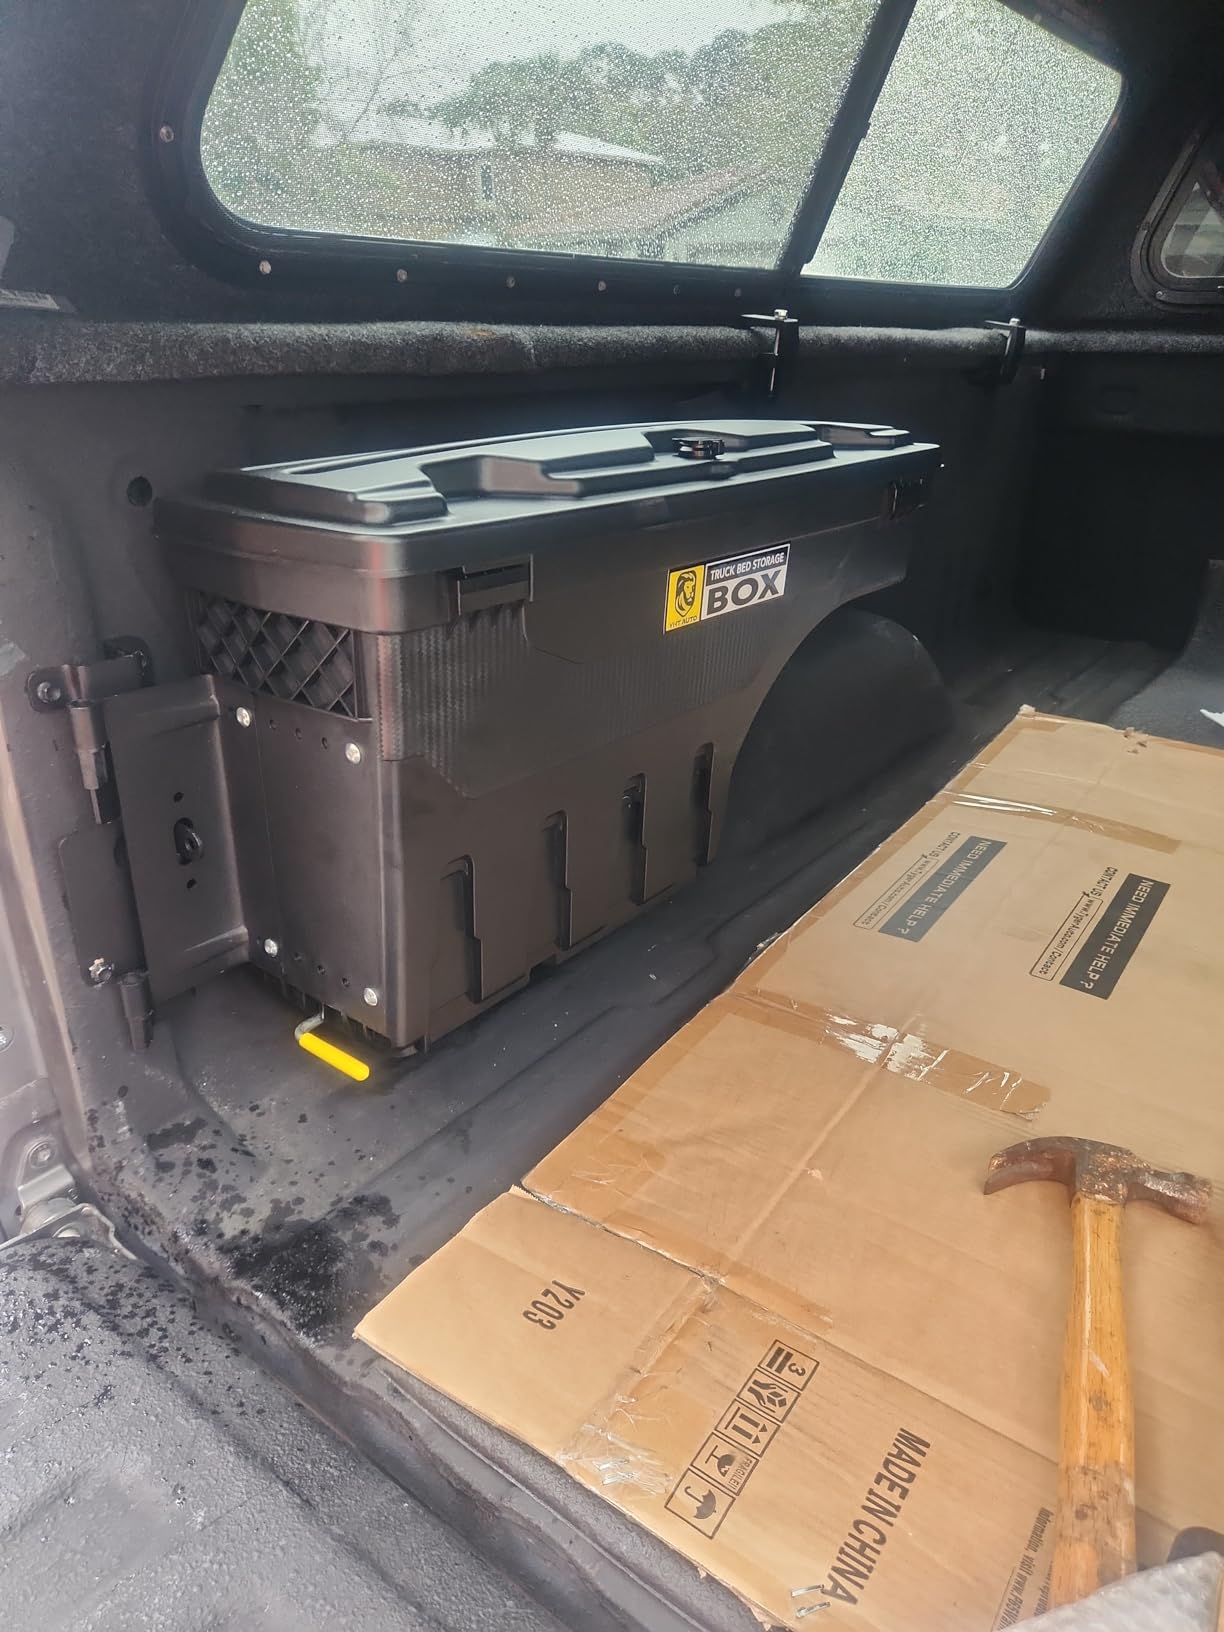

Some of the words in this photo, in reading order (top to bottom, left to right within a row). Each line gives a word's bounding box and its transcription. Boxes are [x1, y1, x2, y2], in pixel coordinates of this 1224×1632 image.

[711, 564, 736, 581] TRUCK
[736, 561, 751, 574] BED
[753, 552, 785, 570] STORAGE
[706, 569, 782, 616] BOX
[682, 616, 698, 625] AUTO
[938, 831, 961, 851] CONTACT
[966, 840, 992, 860] NEED
[924, 860, 974, 904] IMMEDIATE
[1096, 866, 1118, 890] CONTACT
[1090, 888, 1102, 898] US
[1131, 879, 1154, 904] NEED
[906, 903, 933, 928] HELP
[1100, 902, 1141, 955] IMMEDIATE
[1087, 953, 1112, 981] HELP
[1080, 980, 1095, 990] ?
[522, 1280, 586, 1330] Y203
[787, 1361, 806, 1378] 3
[873, 1427, 931, 1501] MADE
[860, 1487, 902, 1527] IN
[820, 1518, 888, 1605] CHINA
